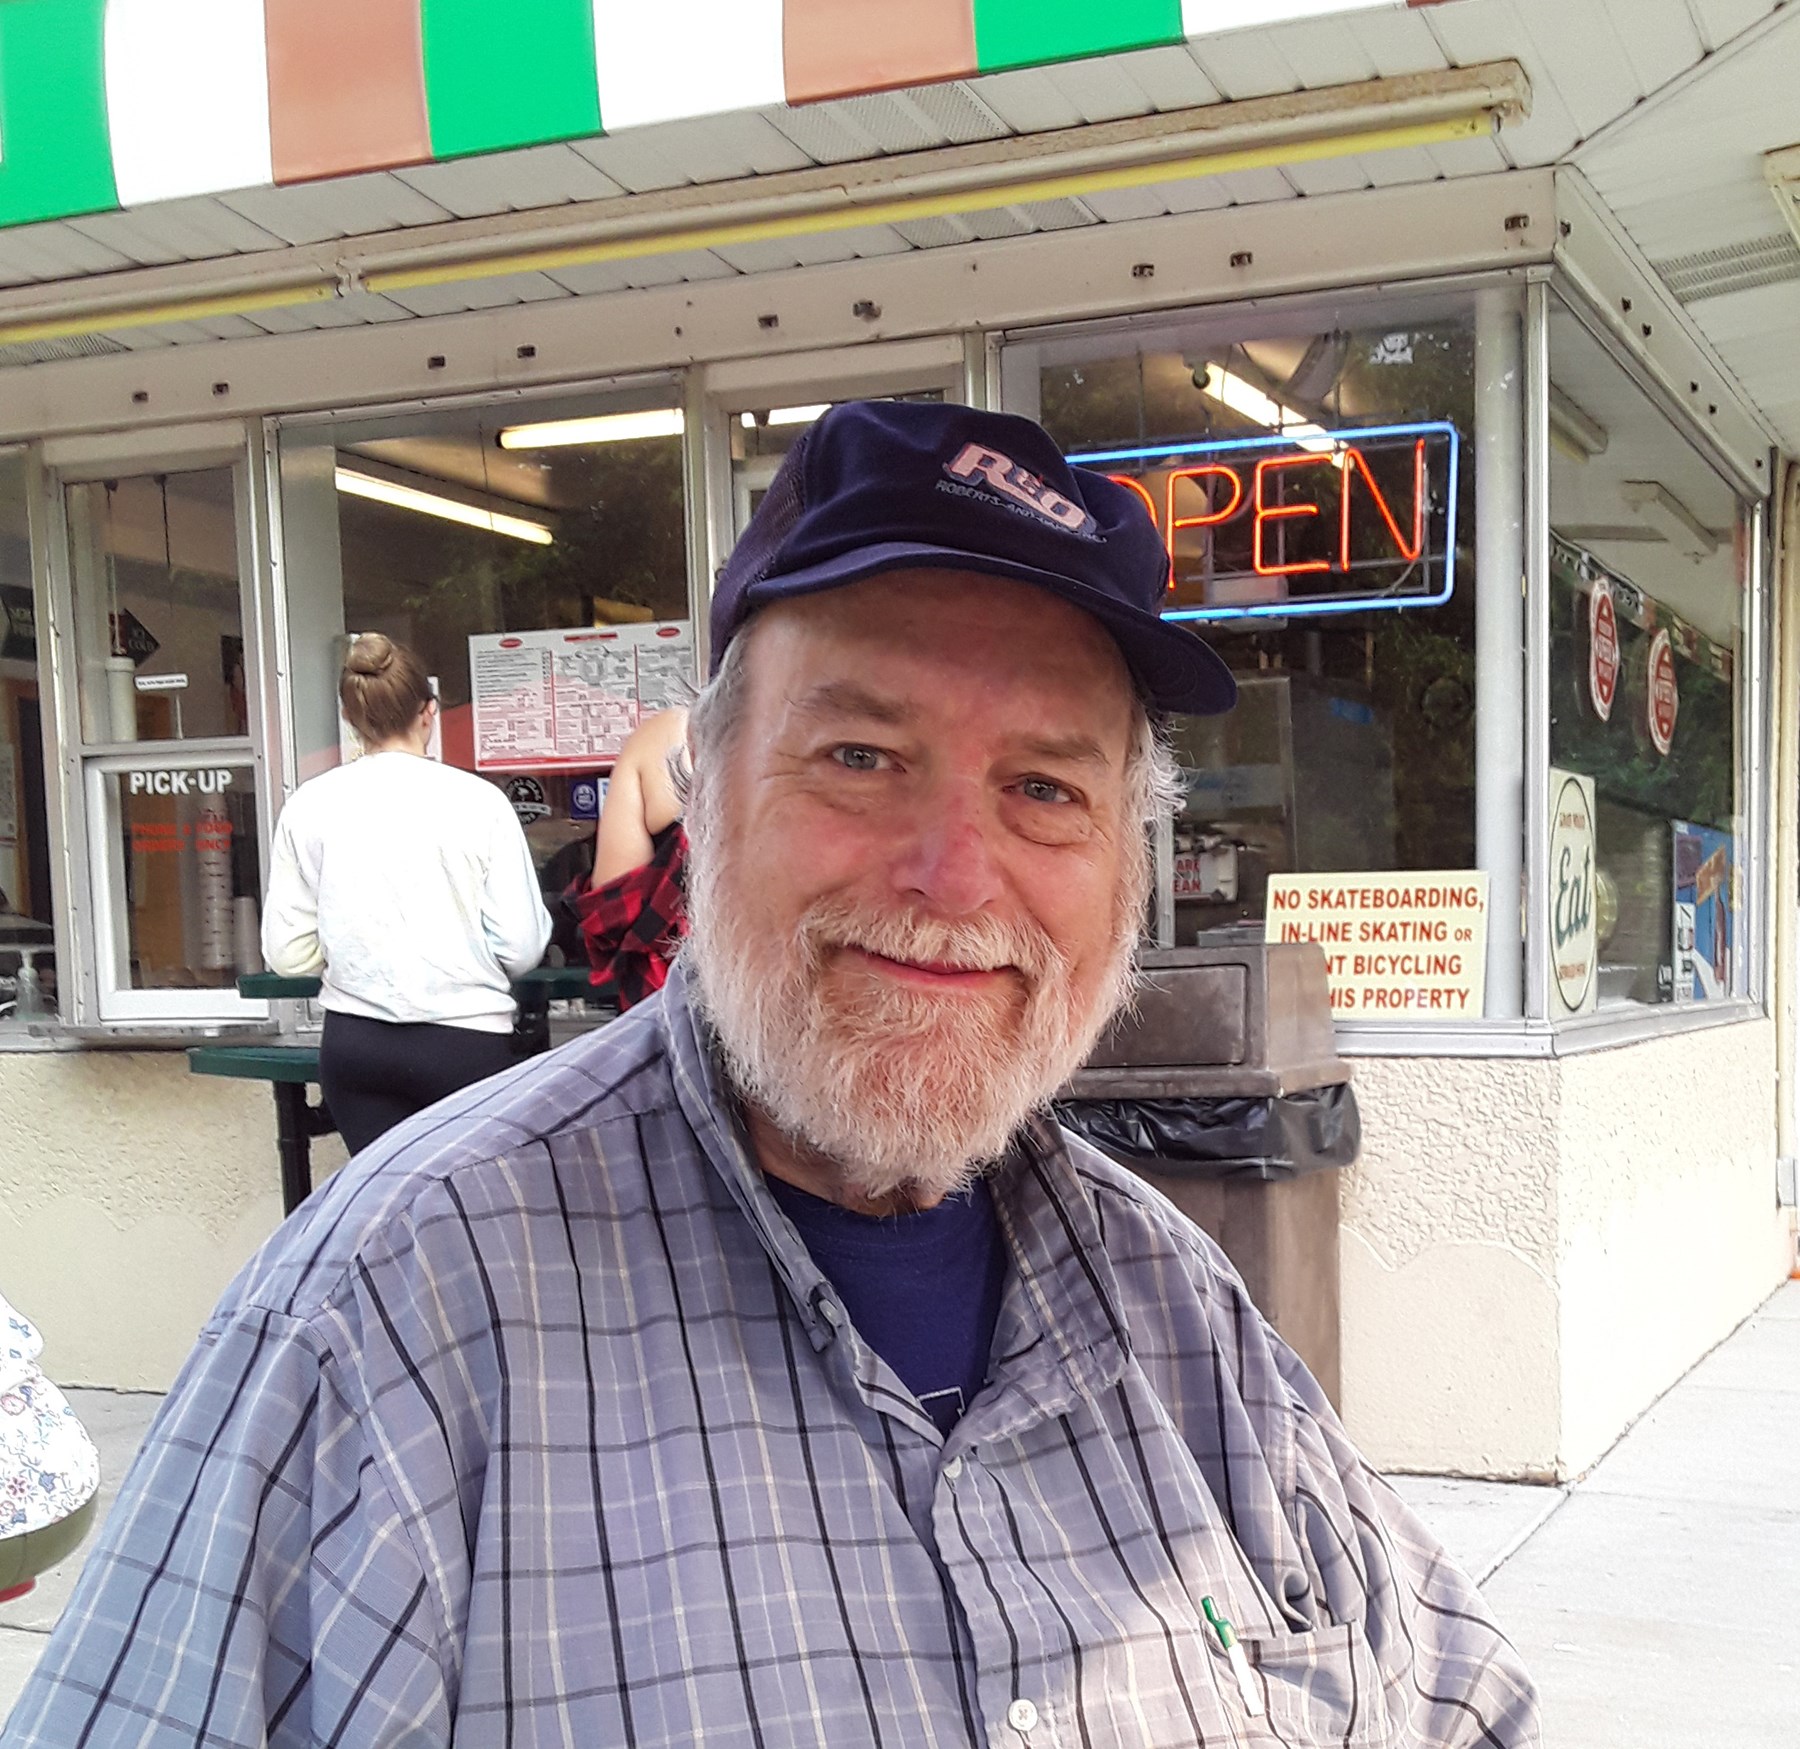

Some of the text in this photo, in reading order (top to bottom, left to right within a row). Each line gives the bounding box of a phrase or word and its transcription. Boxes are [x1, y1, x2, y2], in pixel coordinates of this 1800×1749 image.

[1106, 438, 1426, 591] PEN
[130, 769, 233, 796] PICK-UP
[1173, 879, 1200, 893] EAN
[1555, 846, 1592, 948] Eat
[1273, 886, 1484, 913] NO SKATEBOARDING,
[1281, 921, 1472, 943] IN-LINE SKATING OR
[1325, 954, 1462, 975] NT BICYCLING
[1329, 987, 1470, 1009] HIS PROPERTY
